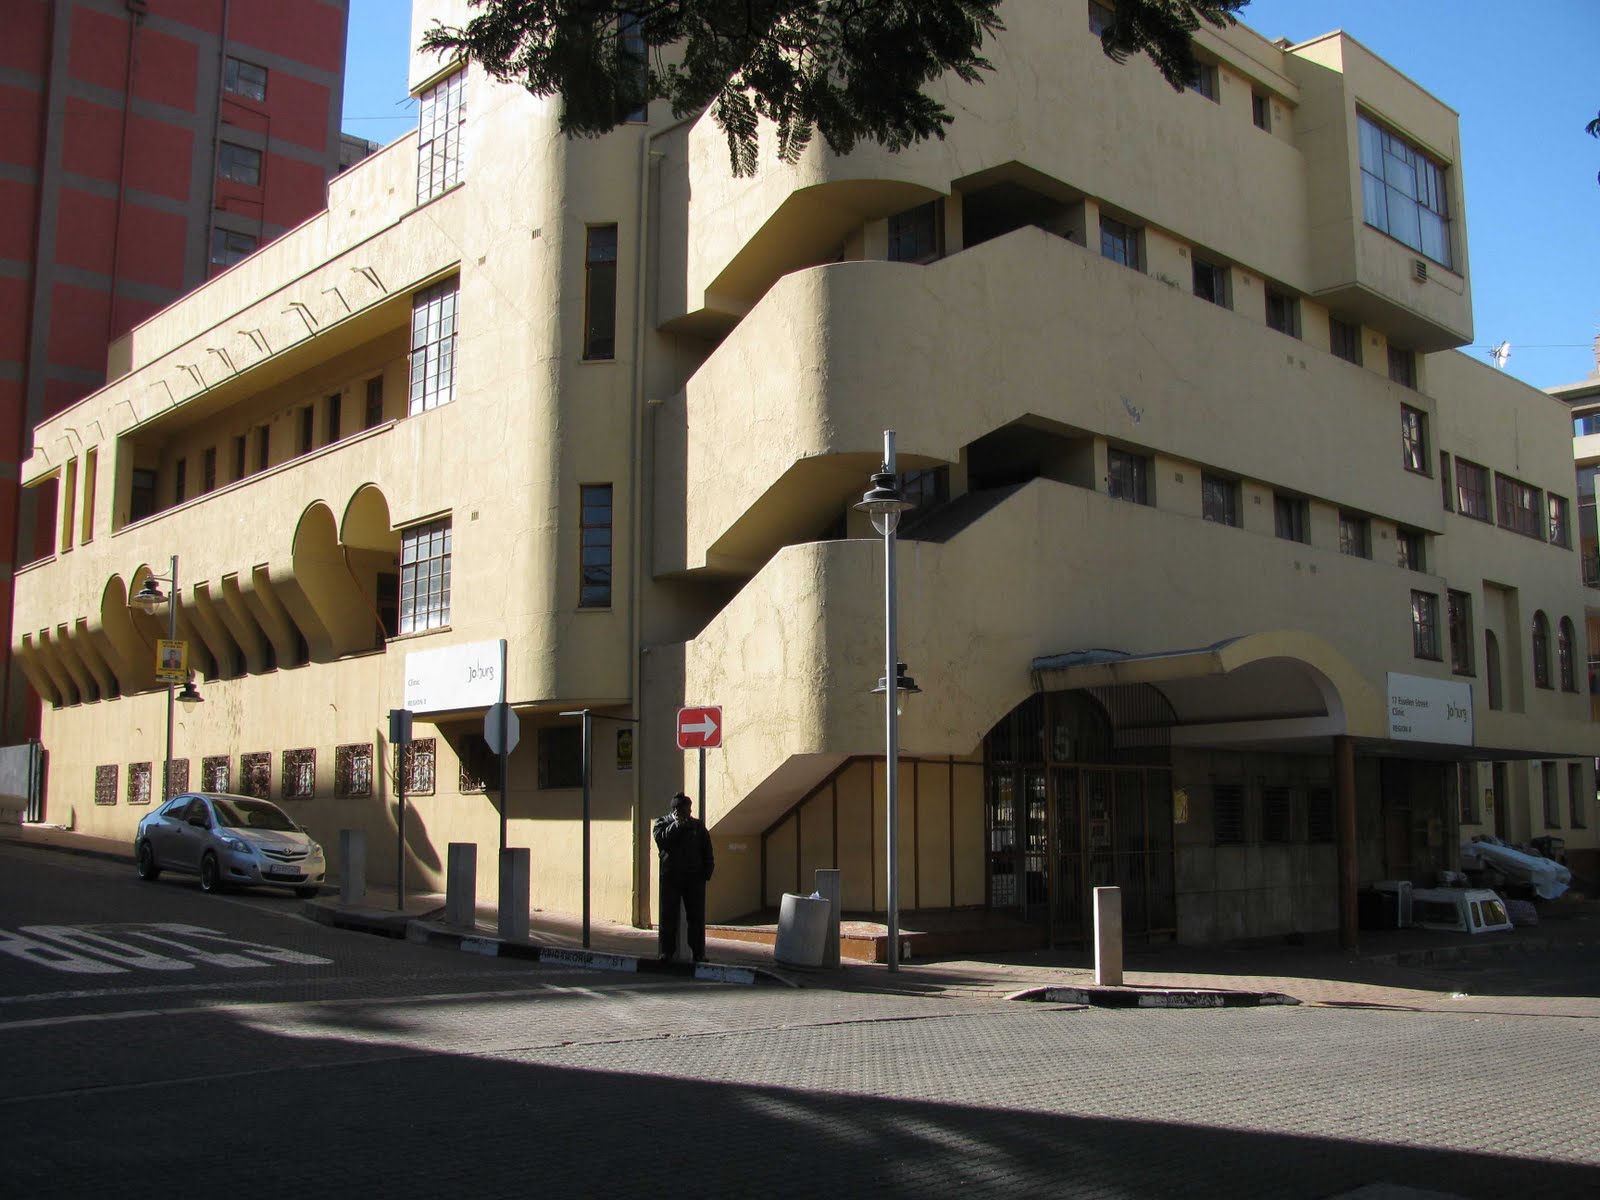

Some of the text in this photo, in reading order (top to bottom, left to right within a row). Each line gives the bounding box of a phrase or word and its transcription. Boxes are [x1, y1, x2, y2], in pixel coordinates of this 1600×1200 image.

[408, 678, 420, 687] Clinic
[1398, 696, 1415, 706] Esselen
[1415, 698, 1428, 708] Street
[1392, 708, 1405, 716] Clinic
